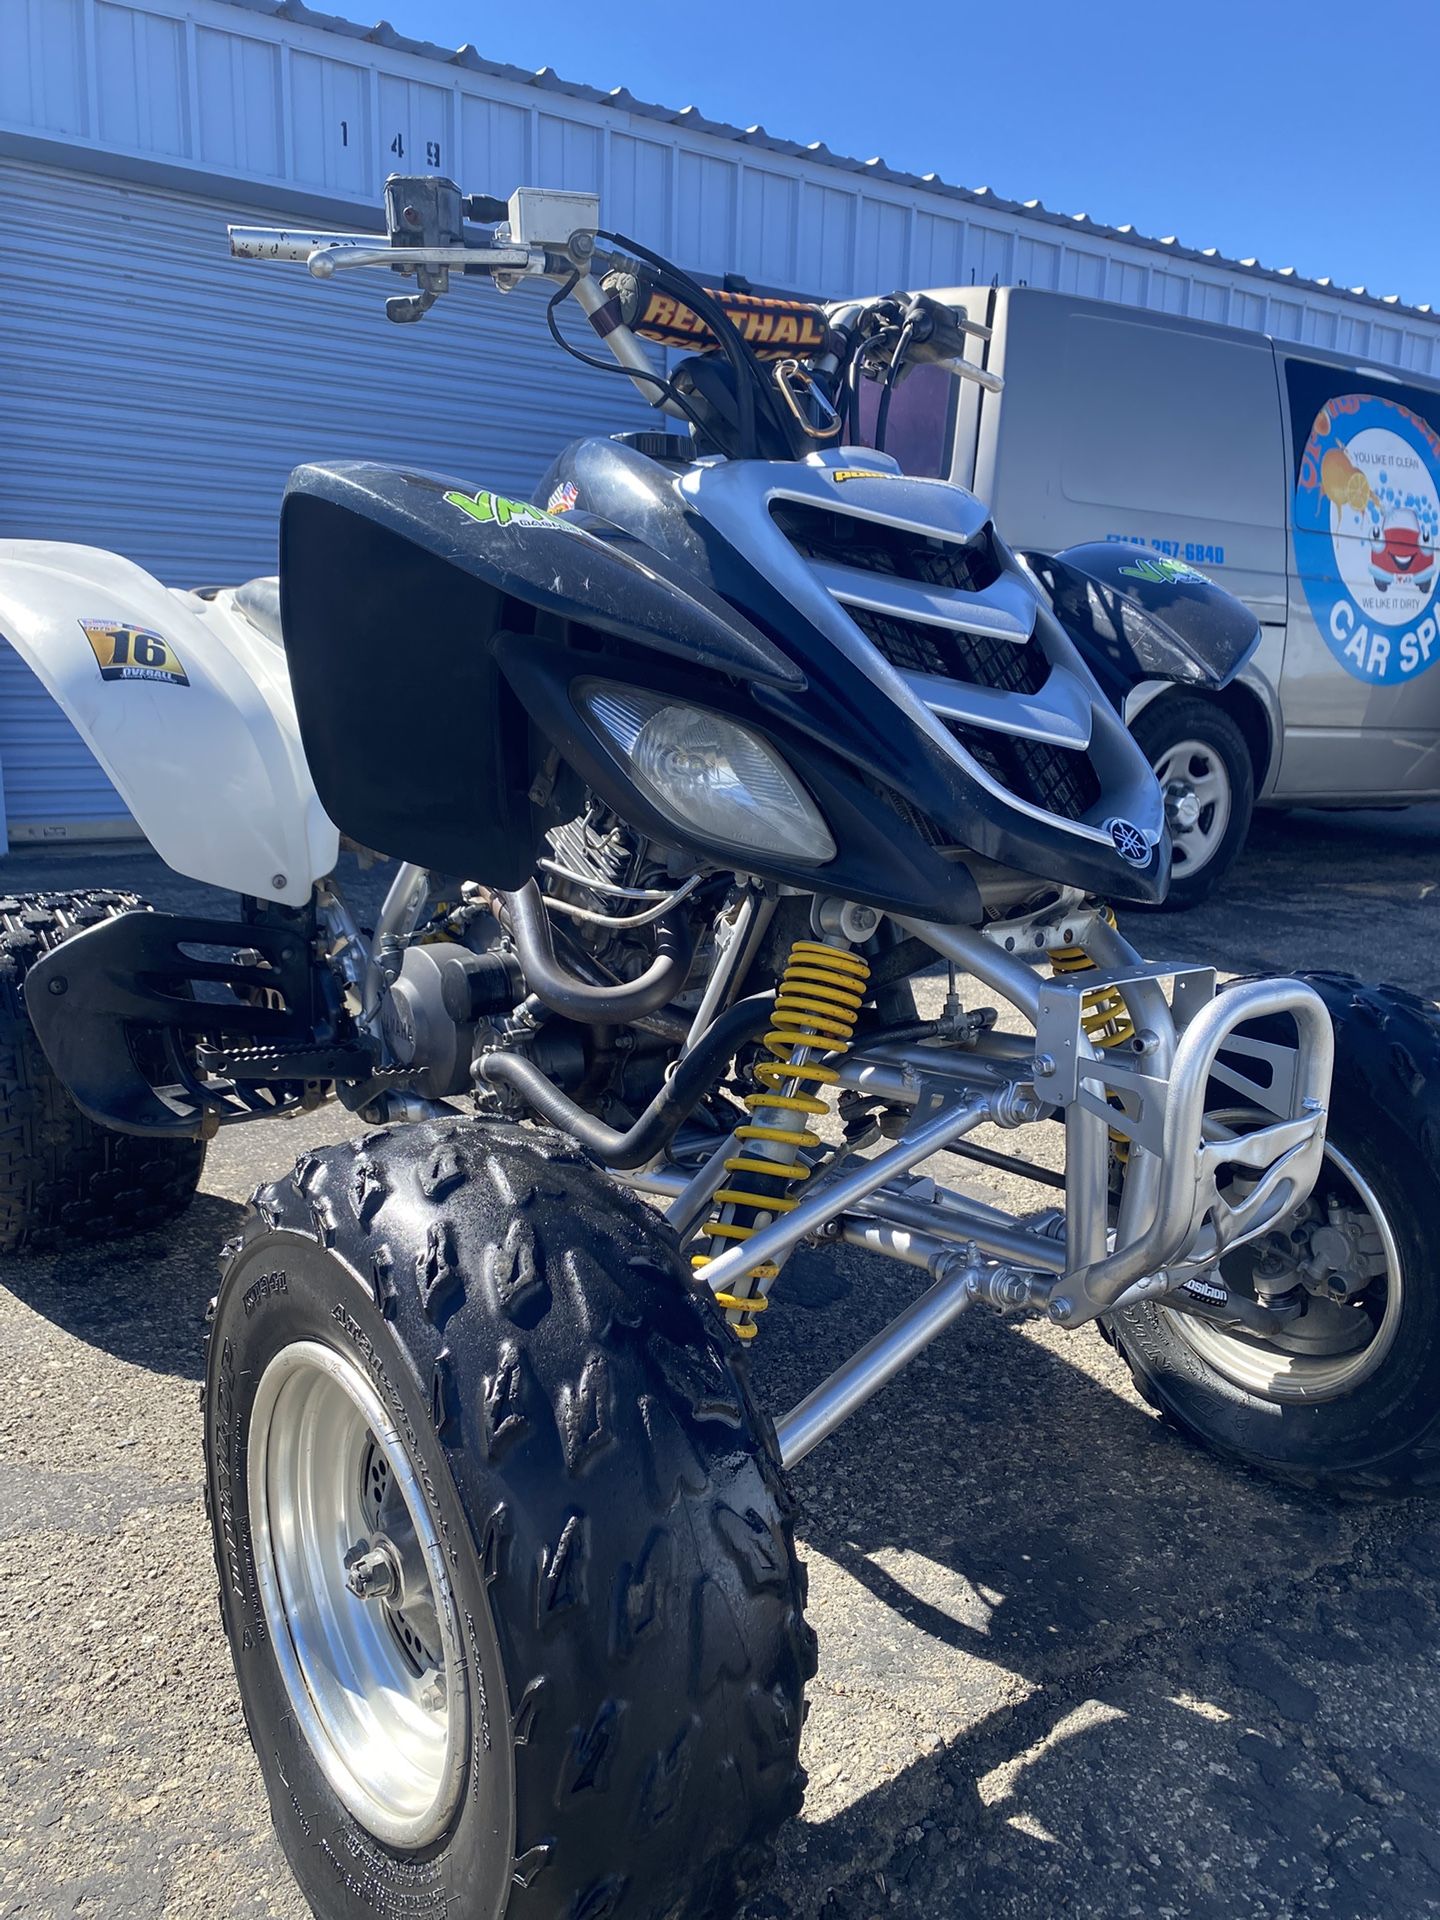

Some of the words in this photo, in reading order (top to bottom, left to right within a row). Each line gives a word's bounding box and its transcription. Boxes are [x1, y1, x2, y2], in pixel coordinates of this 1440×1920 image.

[1353, 452, 1370, 464] YOU
[1371, 454, 1388, 466] LIKE
[1396, 456, 1419, 469] CLEAN
[1362, 598, 1375, 609] WE
[1375, 598, 1391, 609] LIKE
[1400, 599, 1420, 609] DIRTY
[1330, 599, 1391, 678] CAR
[105, 629, 167, 668] 16
[121, 667, 173, 681] OVERALL
